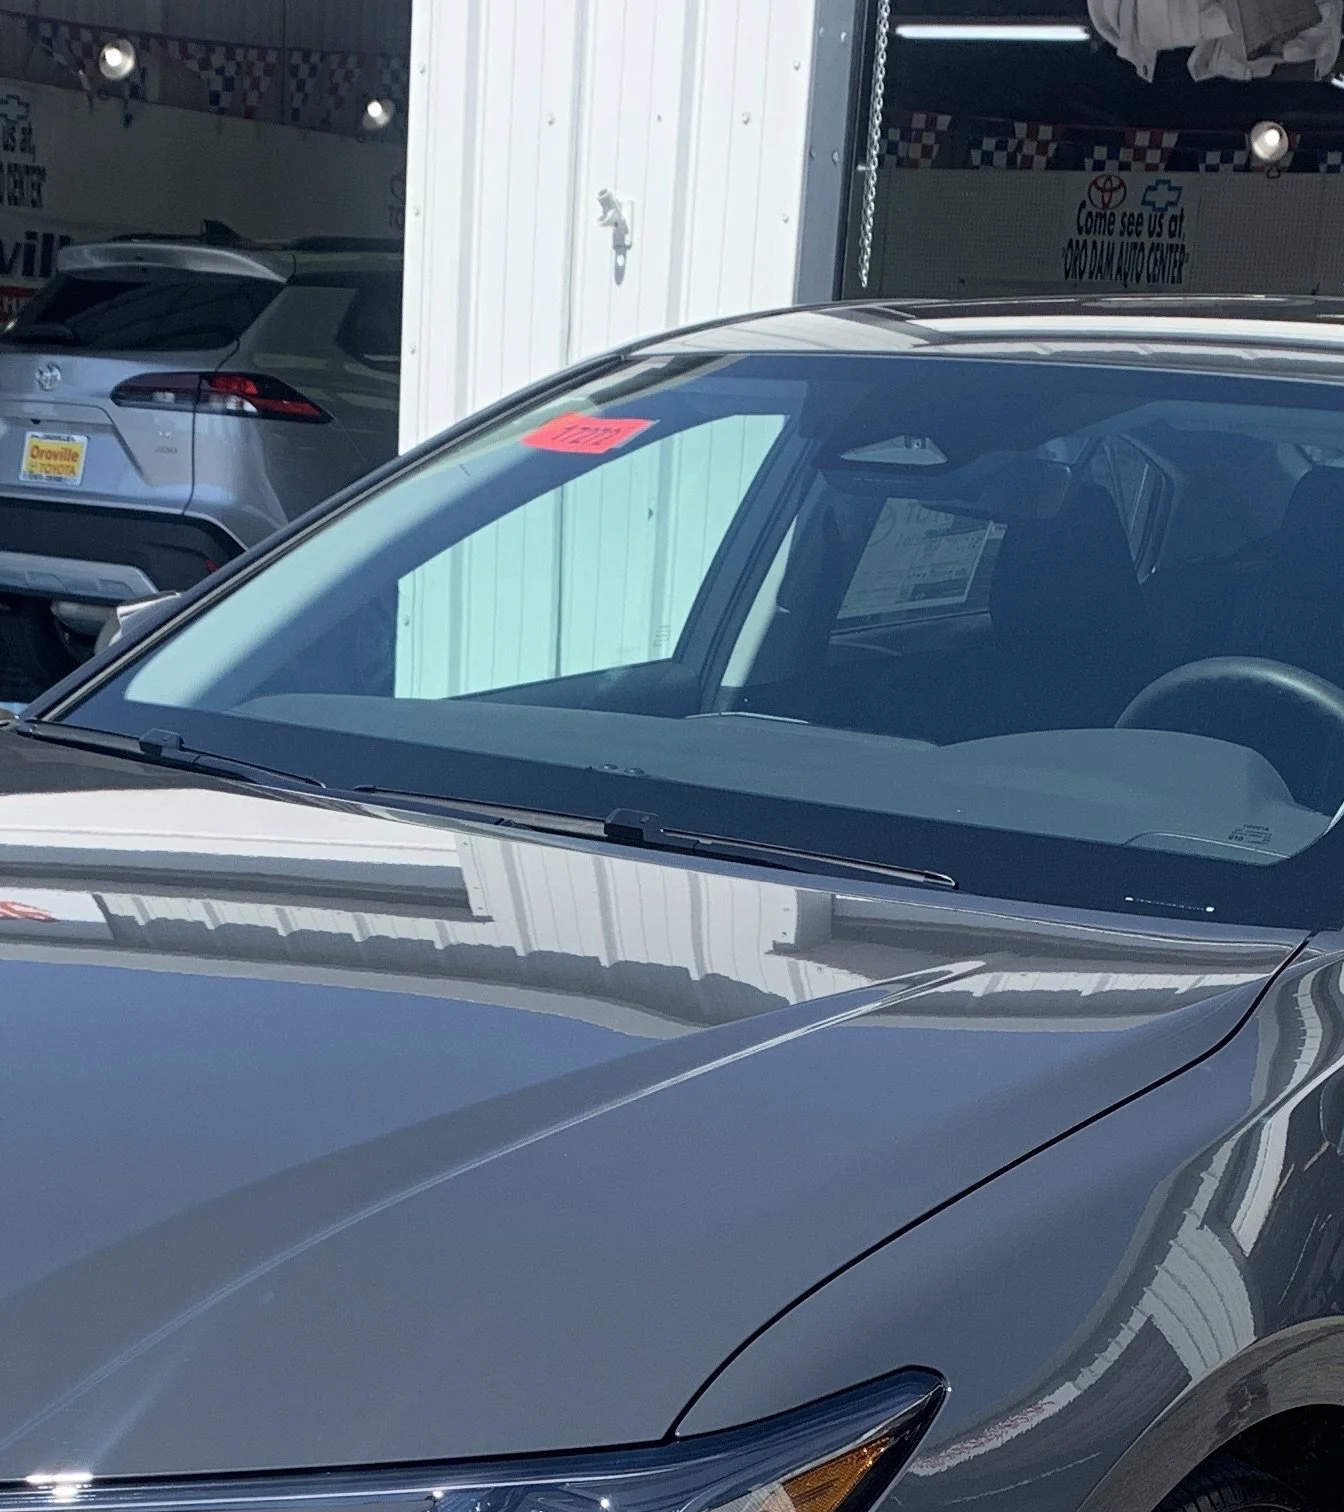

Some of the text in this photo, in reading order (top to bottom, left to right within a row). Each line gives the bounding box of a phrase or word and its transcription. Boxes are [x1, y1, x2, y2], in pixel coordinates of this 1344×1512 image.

[1076, 199, 1116, 237] Come
[1118, 211, 1144, 237] see
[1147, 210, 1164, 238] us
[30, 444, 80, 463] Oroville
